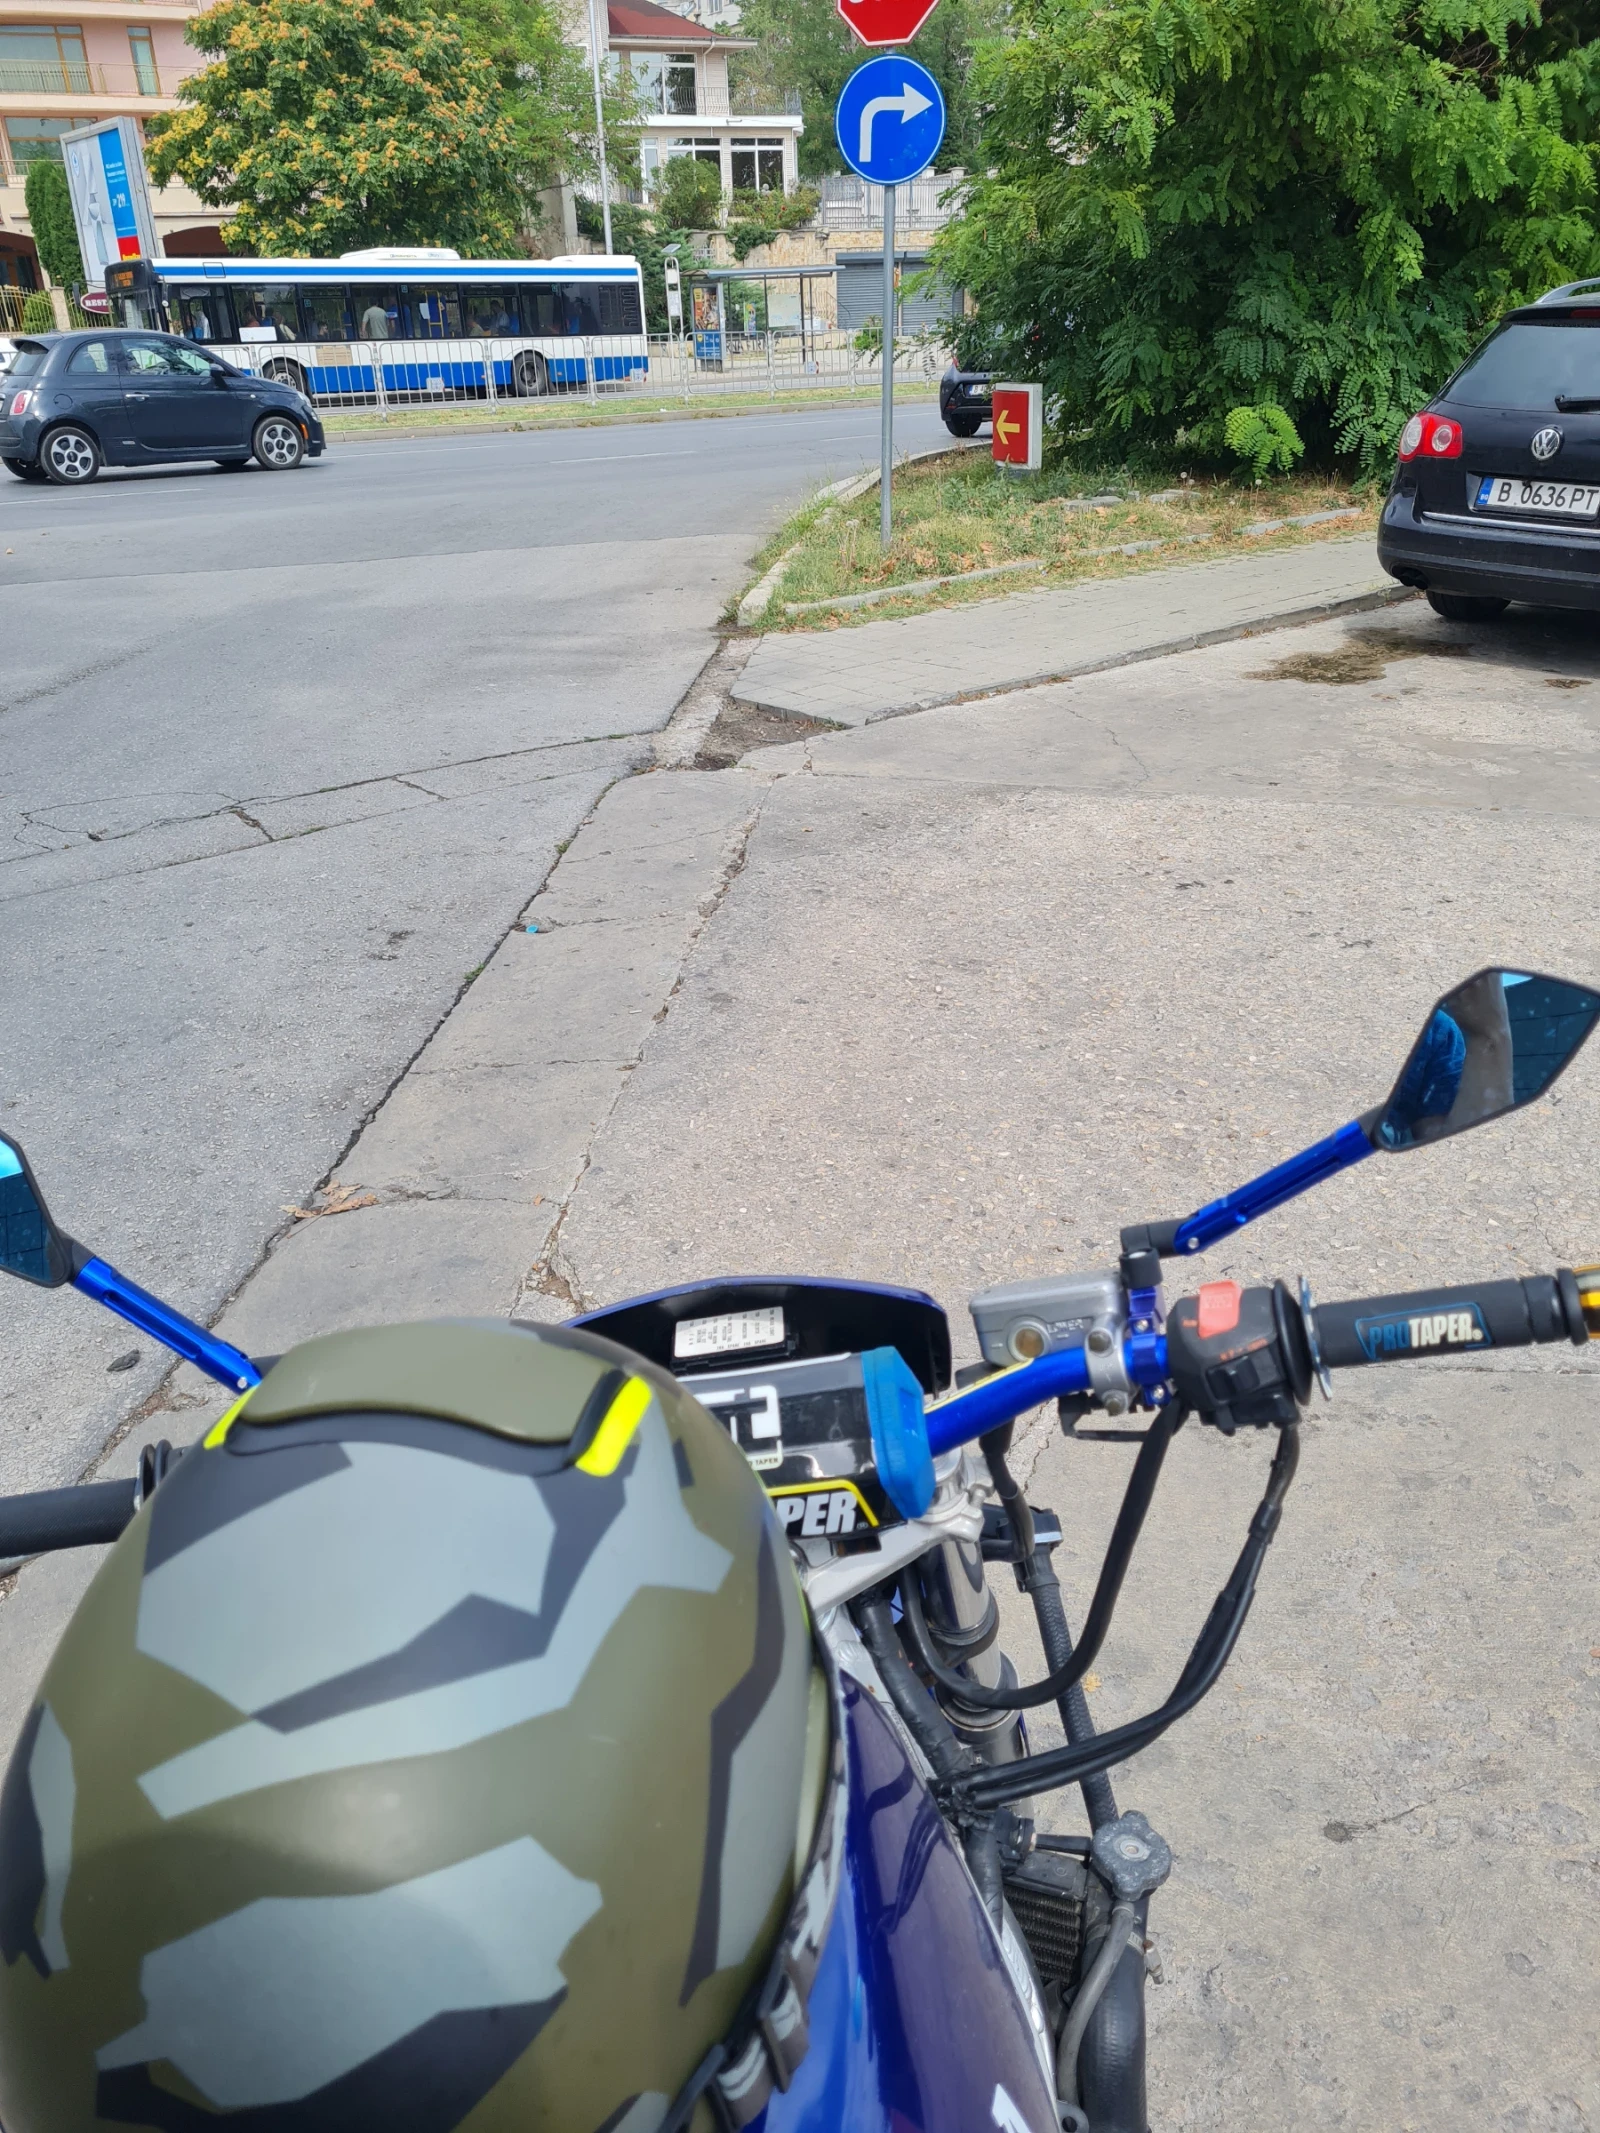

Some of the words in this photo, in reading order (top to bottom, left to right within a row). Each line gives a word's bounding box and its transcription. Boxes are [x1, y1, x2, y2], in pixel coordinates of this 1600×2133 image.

[1497, 482, 1512, 502] B
[1521, 482, 1567, 507] 0636
[1568, 488, 1600, 510] PT
[756, 1457, 778, 1465] TAPER
